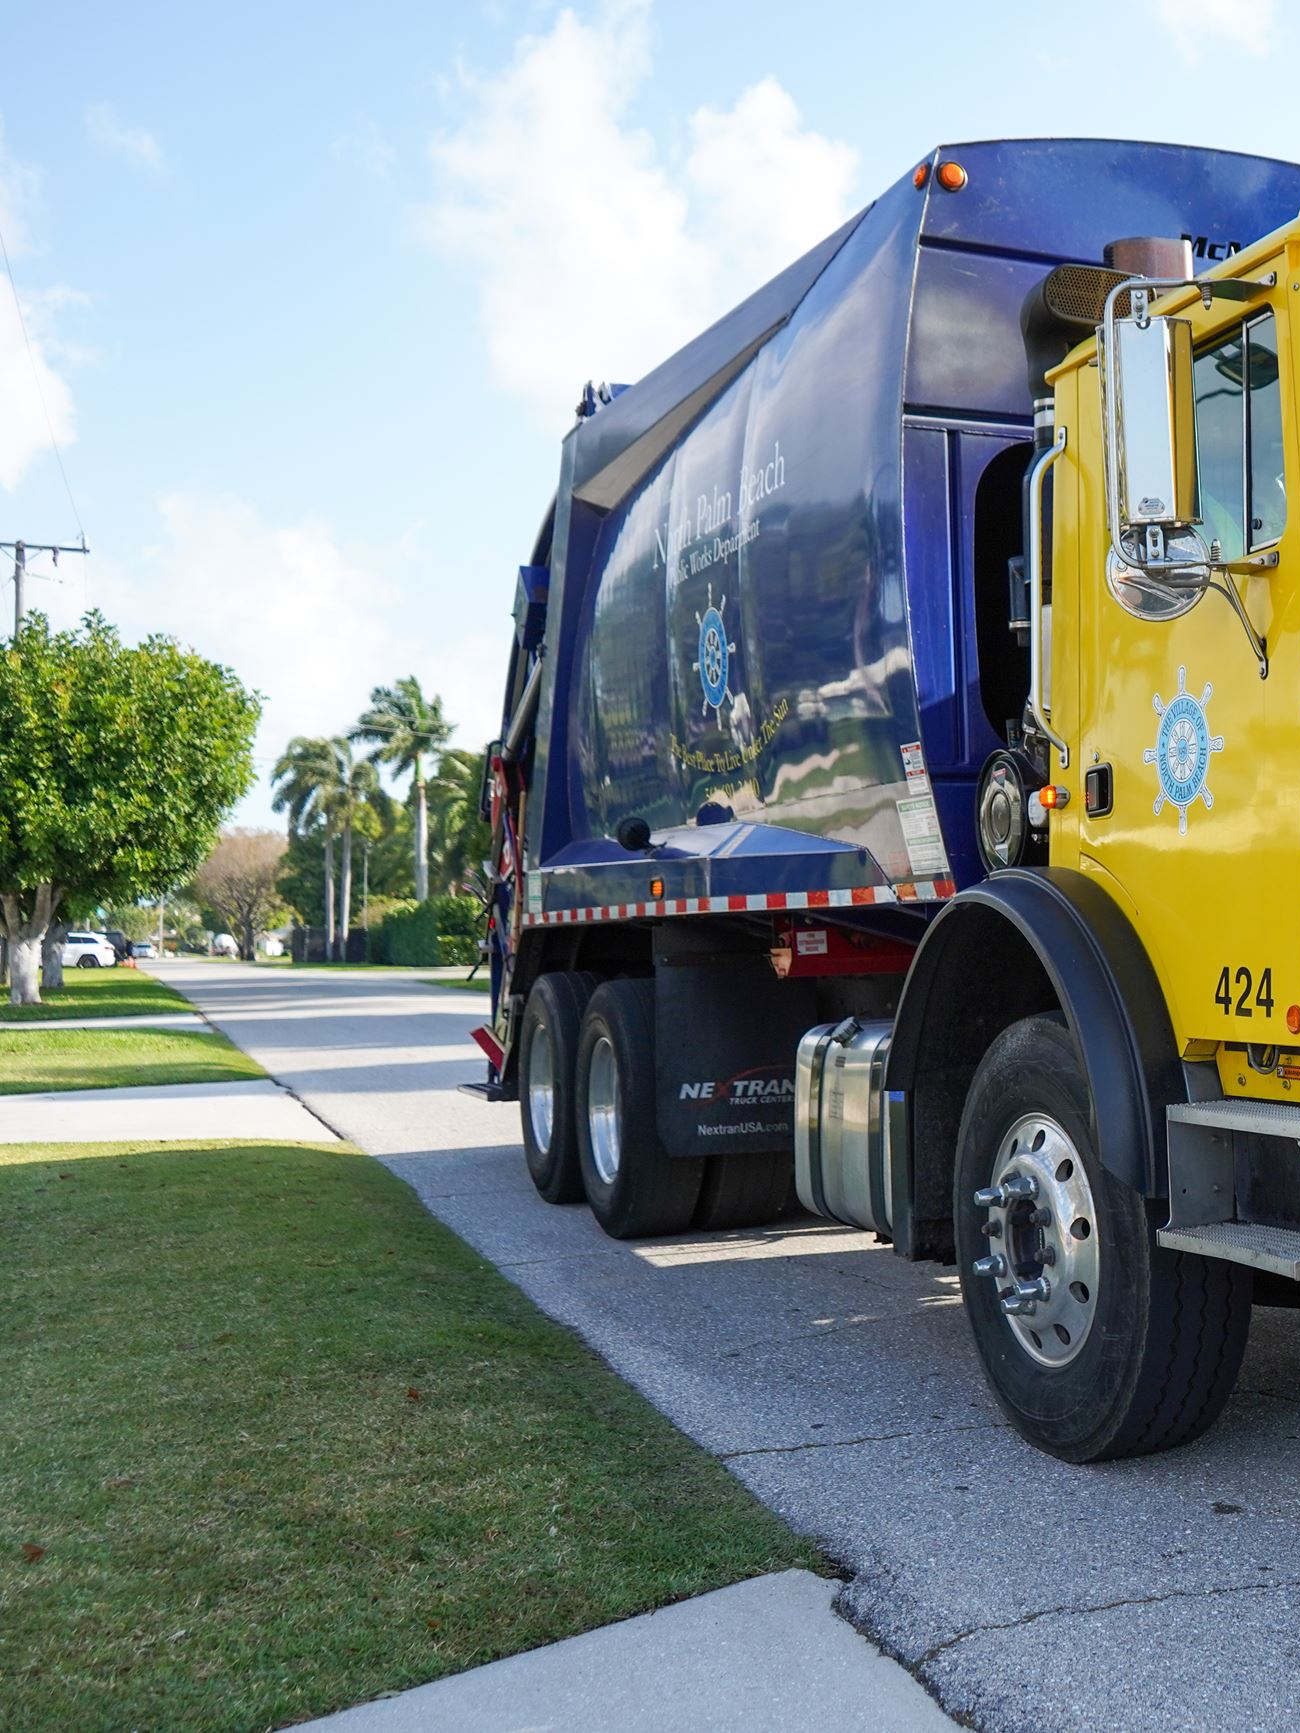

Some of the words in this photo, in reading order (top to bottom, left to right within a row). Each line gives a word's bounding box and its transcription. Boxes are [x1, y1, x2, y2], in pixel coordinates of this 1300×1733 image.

[1181, 234, 1250, 261] McN
[695, 484, 732, 540] Palm
[737, 440, 785, 515] Beach
[689, 545, 713, 575] Works
[760, 719, 775, 744] The
[773, 698, 789, 727] Sun
[1162, 712, 1174, 737] THE
[1171, 701, 1197, 721] VILLAGE
[1195, 716, 1205, 732] OF
[1160, 753, 1174, 794] NORTH
[1174, 785, 1193, 800] PALM
[1192, 747, 1207, 789] BEACH
[1215, 966, 1275, 1018] 424
[679, 1079, 795, 1099] NEXTRAN
[729, 1097, 758, 1105] TRUCK
[697, 1121, 789, 1136] NextranUSA.com
